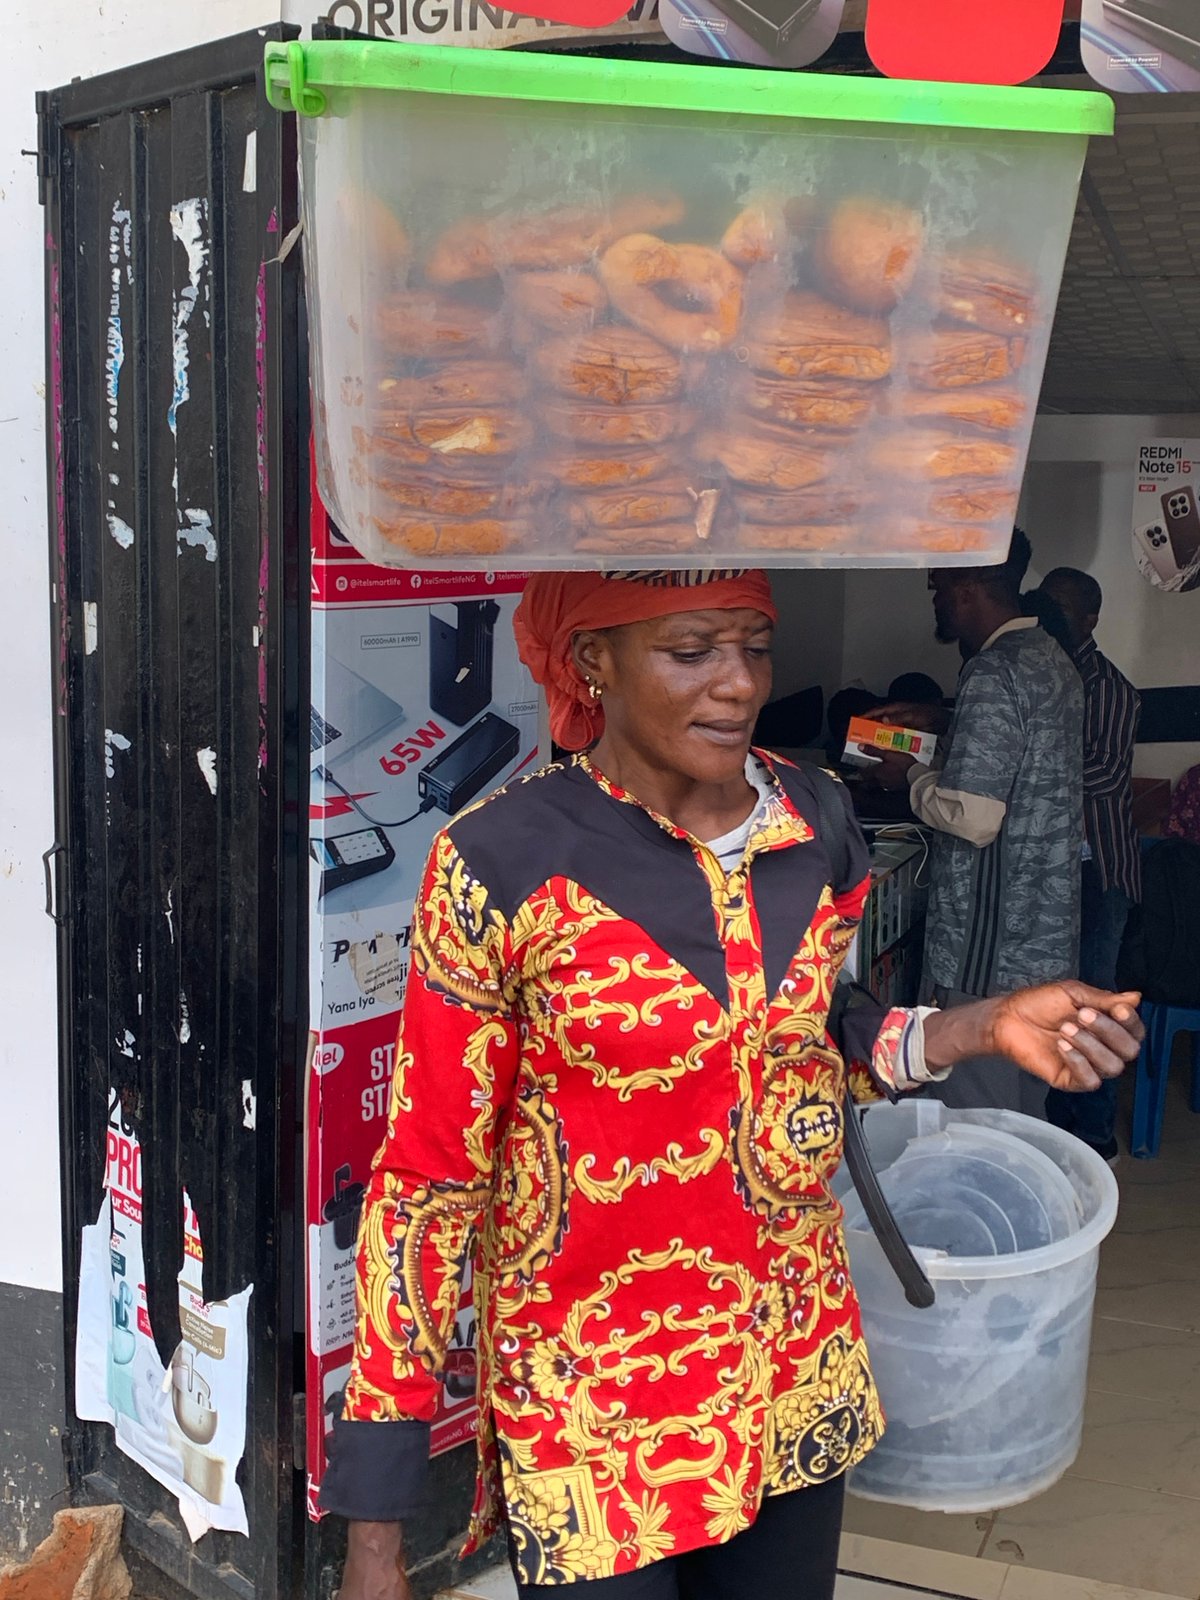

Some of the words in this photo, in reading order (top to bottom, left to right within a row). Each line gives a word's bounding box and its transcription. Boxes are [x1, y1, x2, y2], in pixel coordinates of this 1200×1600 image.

[1140, 446, 1182, 459] REDMI
[1139, 460, 1175, 473] Note
[1176, 460, 1191, 474] 15
[350, 577, 401, 588] @itelsmartlife
[423, 574, 476, 585] itelSmartlifeNG
[379, 720, 446, 776] 65W
[328, 1001, 356, 1015] Yana
[359, 996, 375, 1010] Iya
[123, 1200, 142, 1220] Sou
[184, 1232, 203, 1260] Cha
